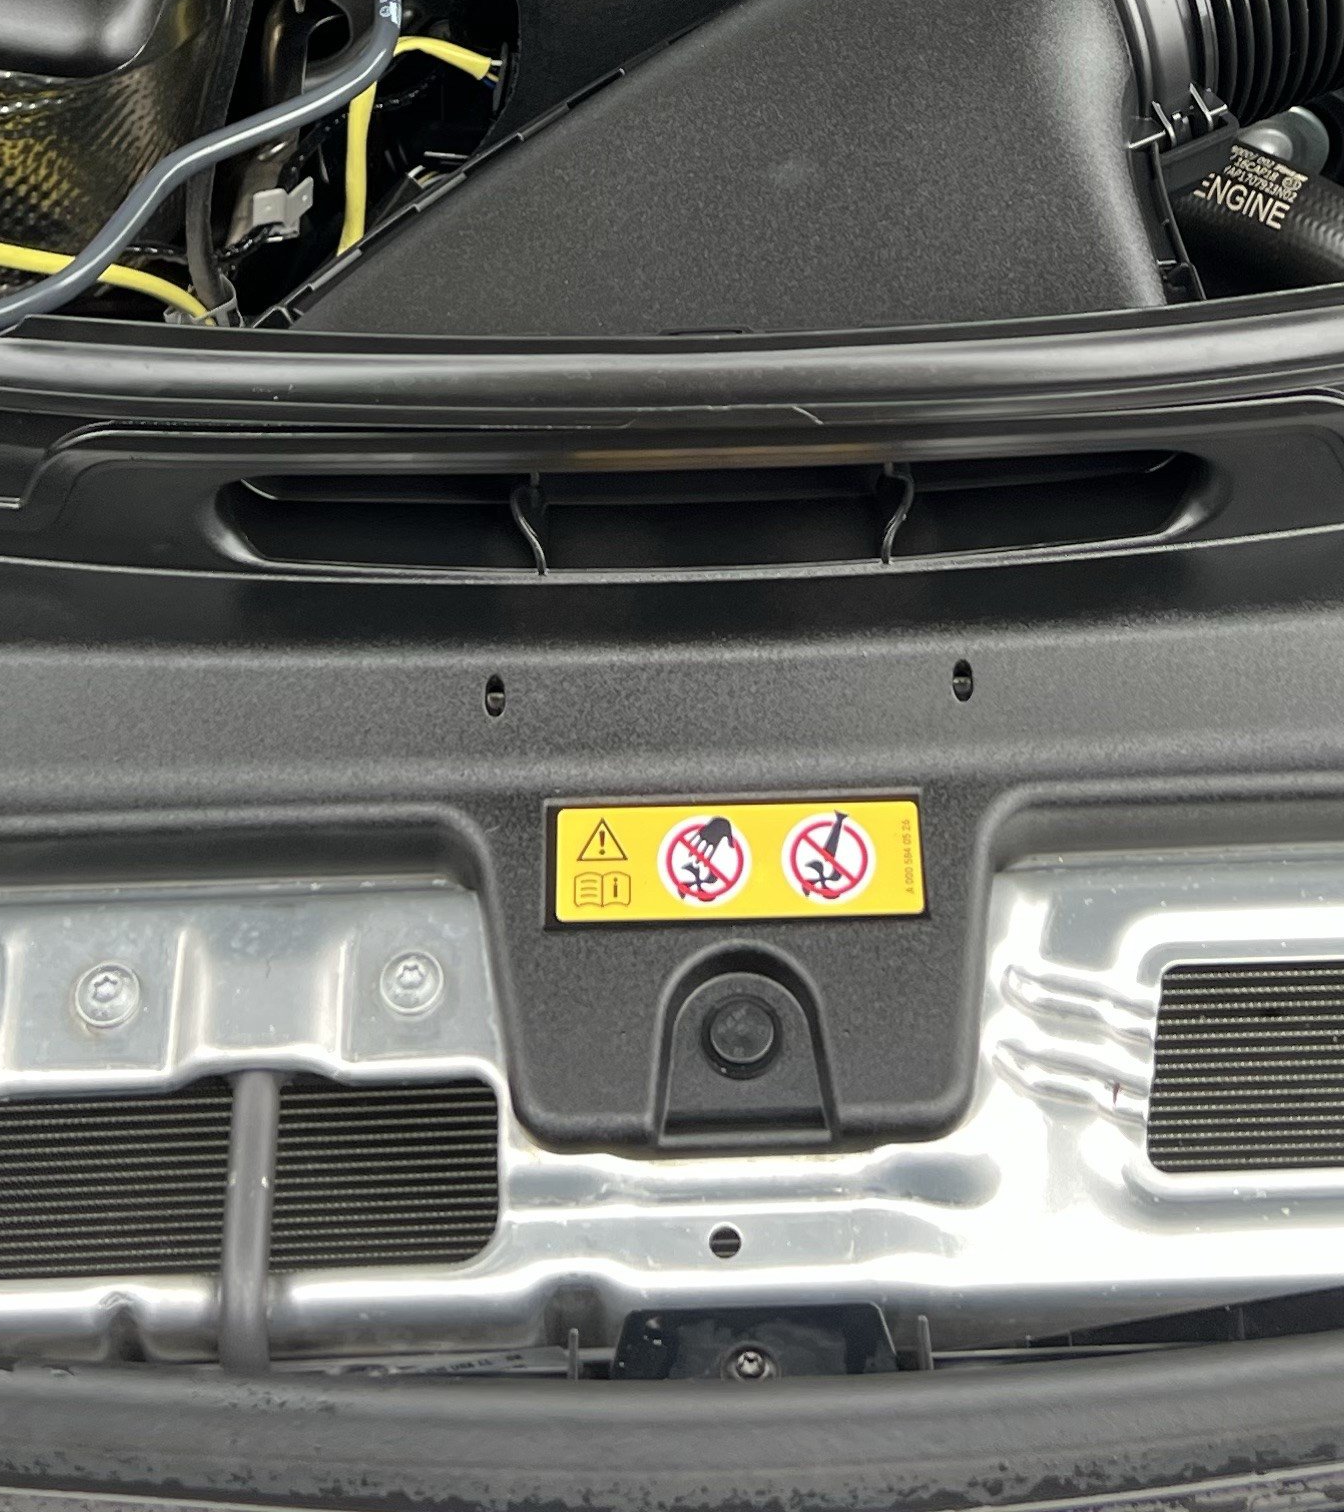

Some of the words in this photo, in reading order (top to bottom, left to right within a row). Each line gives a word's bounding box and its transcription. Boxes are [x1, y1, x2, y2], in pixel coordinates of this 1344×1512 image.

[902, 833, 912, 845] 05
[903, 848, 913, 865] 584
[904, 866, 914, 885] 000
